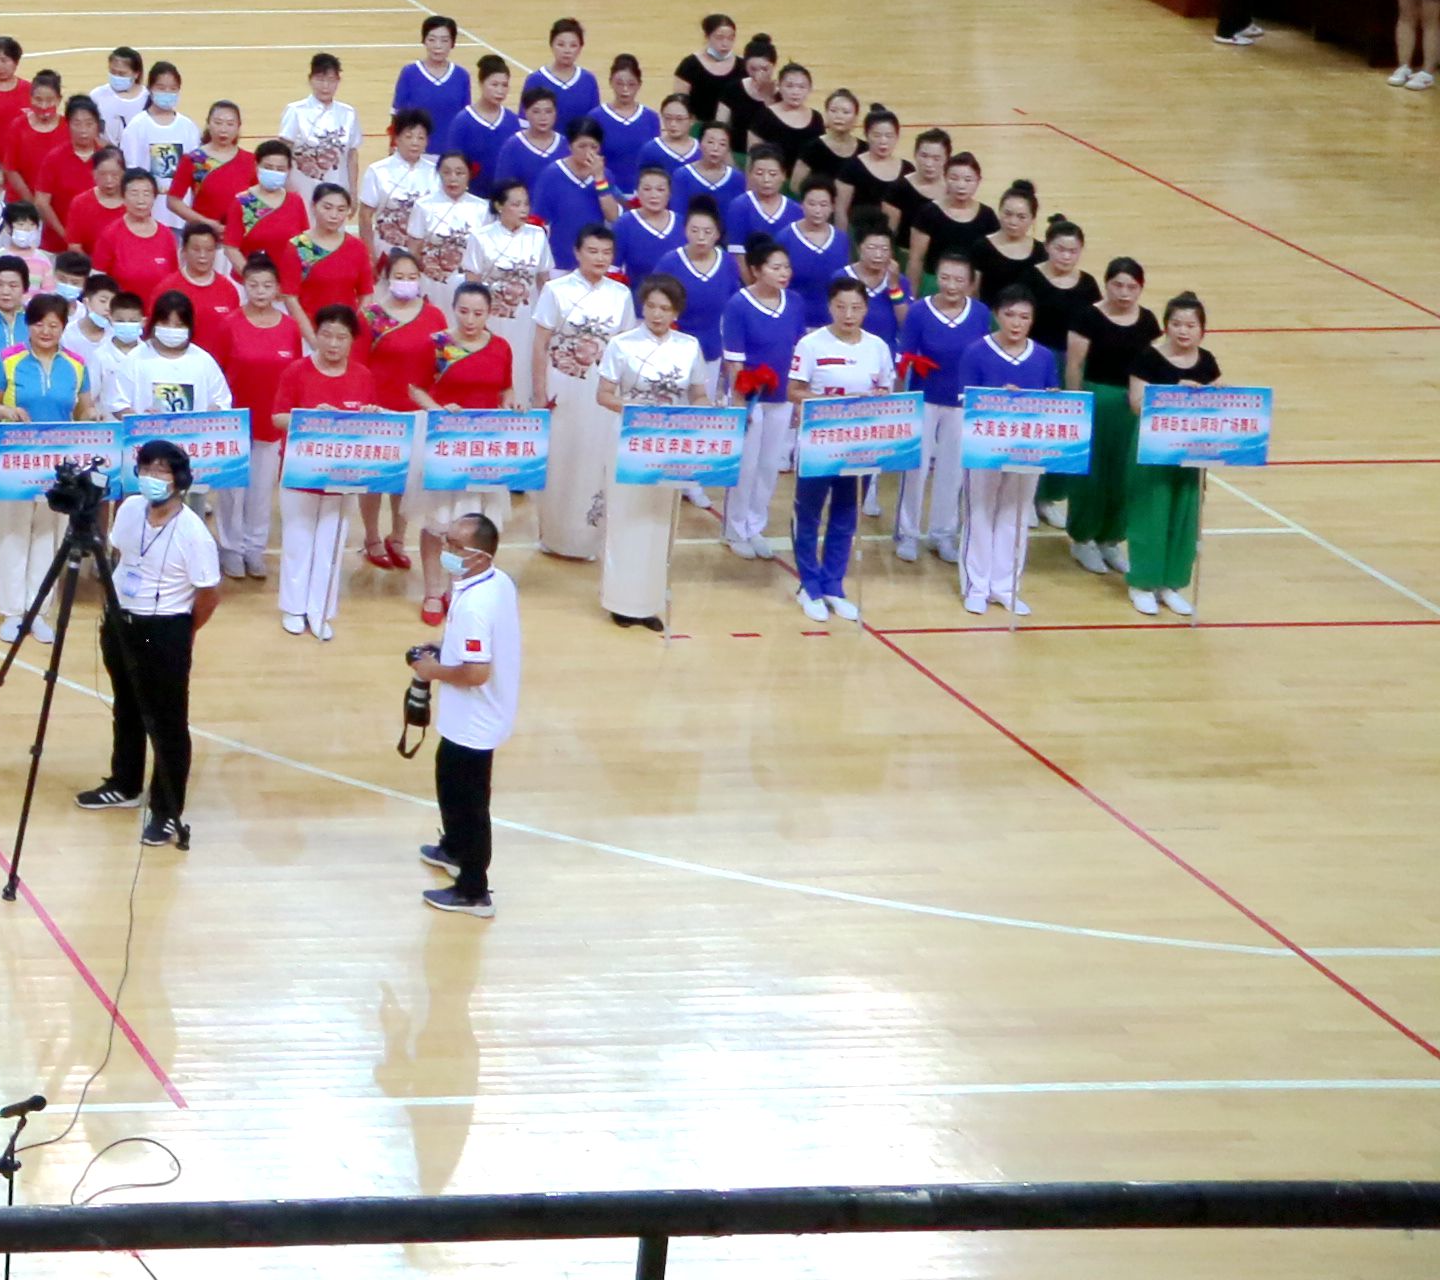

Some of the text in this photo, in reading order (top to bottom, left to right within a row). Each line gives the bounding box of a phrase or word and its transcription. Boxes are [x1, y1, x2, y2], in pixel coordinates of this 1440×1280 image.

[434, 441, 536, 458] 北湖国标舞队
